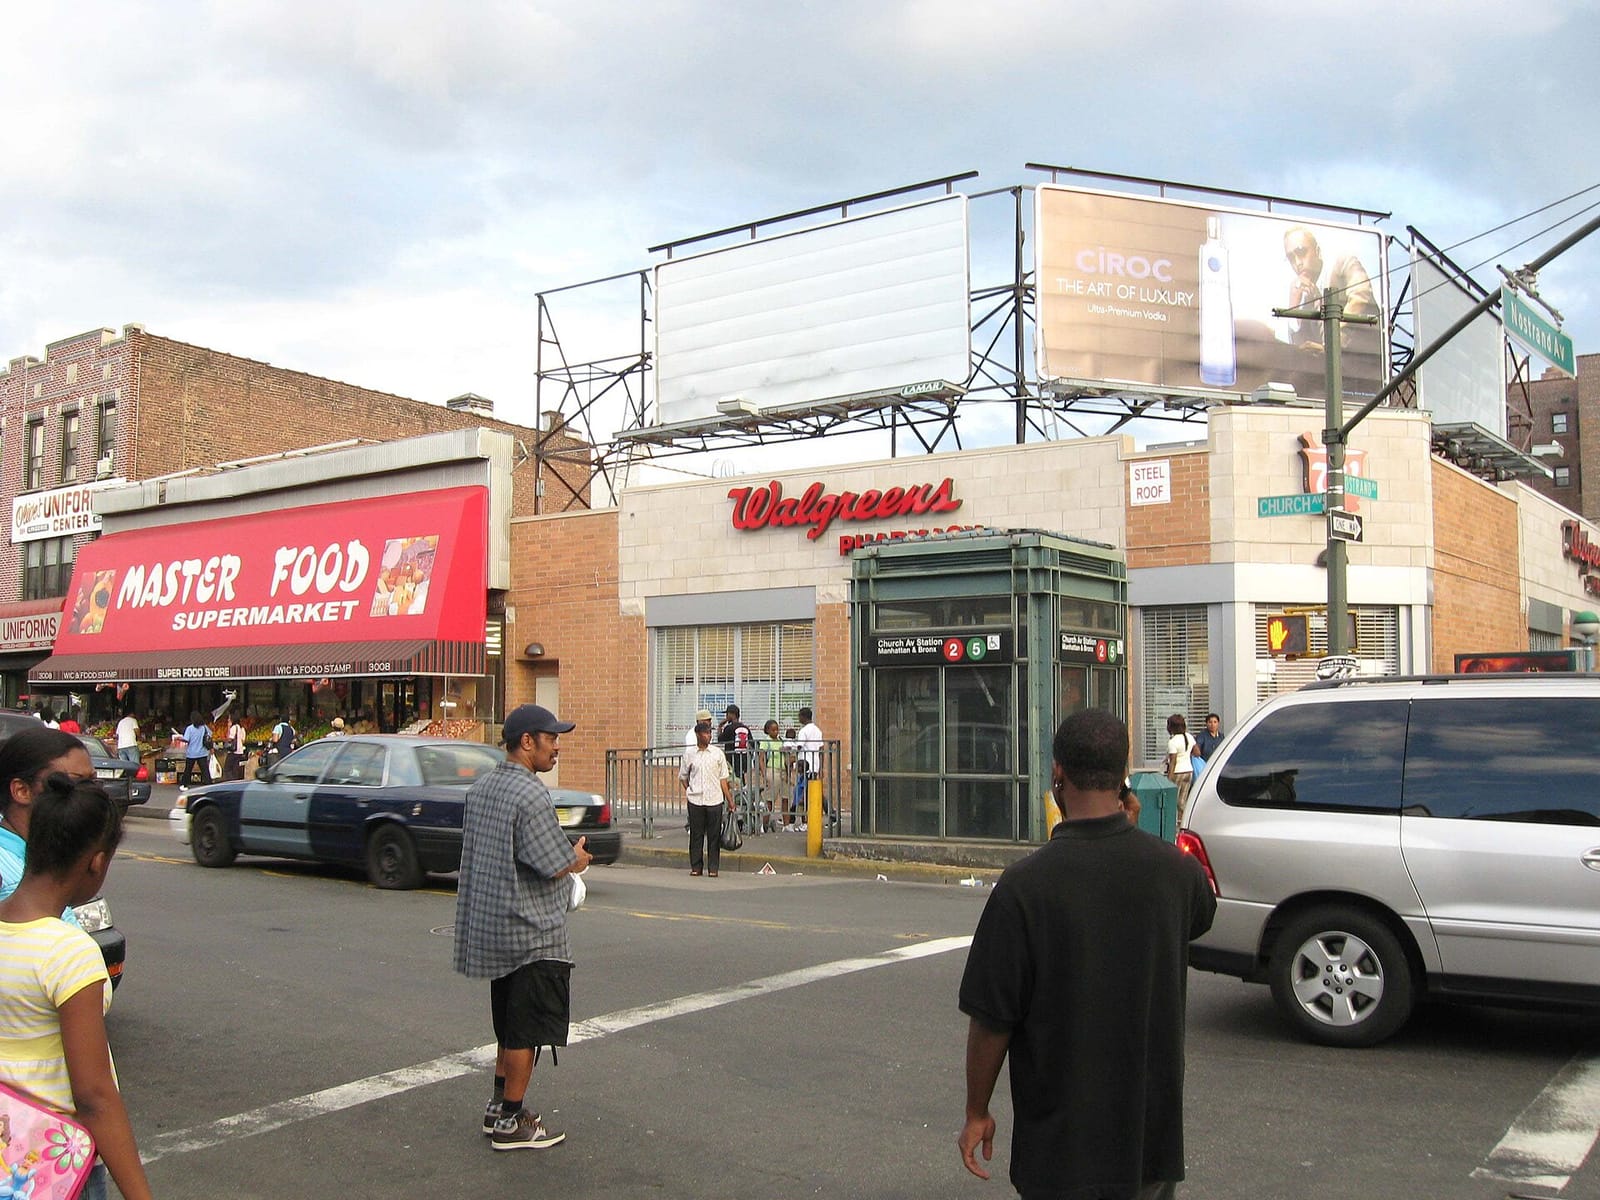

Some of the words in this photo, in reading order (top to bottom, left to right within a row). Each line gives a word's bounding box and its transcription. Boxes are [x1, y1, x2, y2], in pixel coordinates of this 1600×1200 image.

[1056, 278, 1084, 295] THE
[1087, 281, 1112, 297] ART
[1117, 284, 1136, 300] OF
[1140, 287, 1194, 307] LUXURY
[1143, 309, 1167, 321] Vodka
[1511, 301, 1552, 353] Nostrand
[1553, 336, 1565, 361] Av
[904, 381, 943, 394] LAMAR
[1134, 466, 1165, 481] STEEL
[1136, 485, 1164, 500] ROOF
[1344, 475, 1371, 497] OSTRAND
[43, 488, 94, 518] UNIFOR
[727, 477, 963, 542] Walgreens
[1259, 495, 1311, 515] CHURCH
[1311, 496, 1321, 504] AV
[53, 513, 89, 532] CENTER
[1336, 519, 1345, 530] ONE
[1349, 522, 1358, 533] WAY
[117, 554, 241, 609] MASTER
[270, 539, 370, 598] FOOD
[171, 600, 360, 630] SUPERMARKET
[3, 617, 57, 640] UNIFORMS
[877, 639, 904, 648] Church
[905, 639, 915, 647] Av
[916, 637, 943, 646] Station
[877, 647, 911, 655] Manhattan
[80, 672, 97, 680] FOOD
[97, 671, 118, 679] STAMP
[157, 668, 181, 678] SUPER
[182, 668, 203, 677] FOOD
[205, 667, 230, 677] STORE
[277, 666, 292, 675] WIC
[293, 666, 299, 674] &
[300, 665, 323, 674] FOOD
[324, 664, 351, 673] STAMP
[368, 663, 391, 671] 3008
